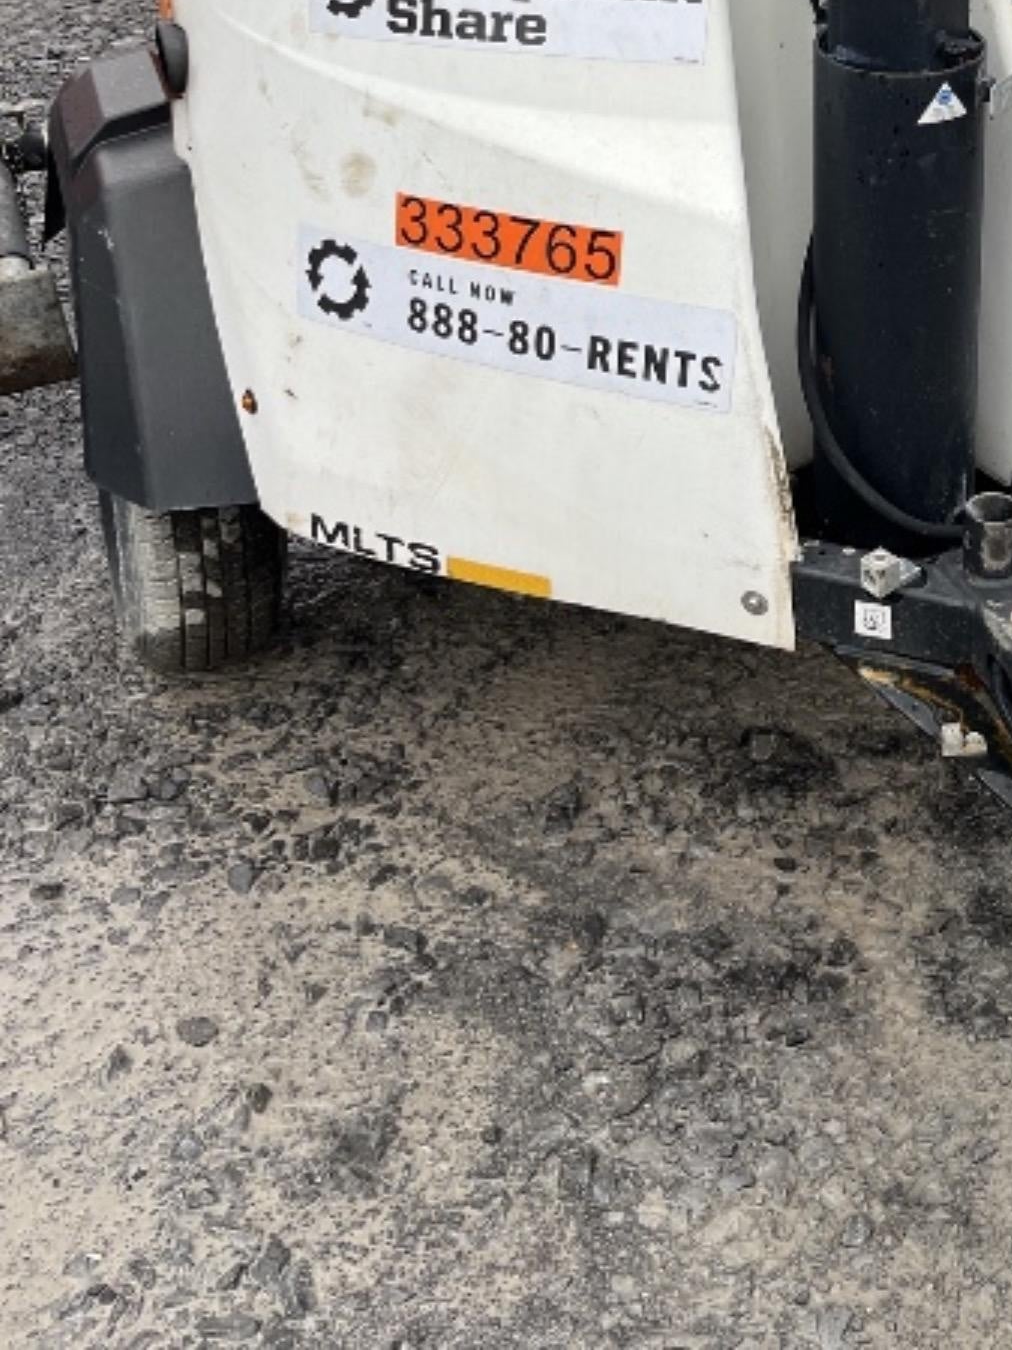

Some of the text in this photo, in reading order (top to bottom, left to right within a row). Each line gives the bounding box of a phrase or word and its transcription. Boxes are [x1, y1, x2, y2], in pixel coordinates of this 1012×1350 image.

[399, 196, 617, 280] 333765
[408, 268, 516, 307] CALL NOW
[407, 296, 725, 395] 888-80-RENTS
[310, 511, 442, 575] MLTS
